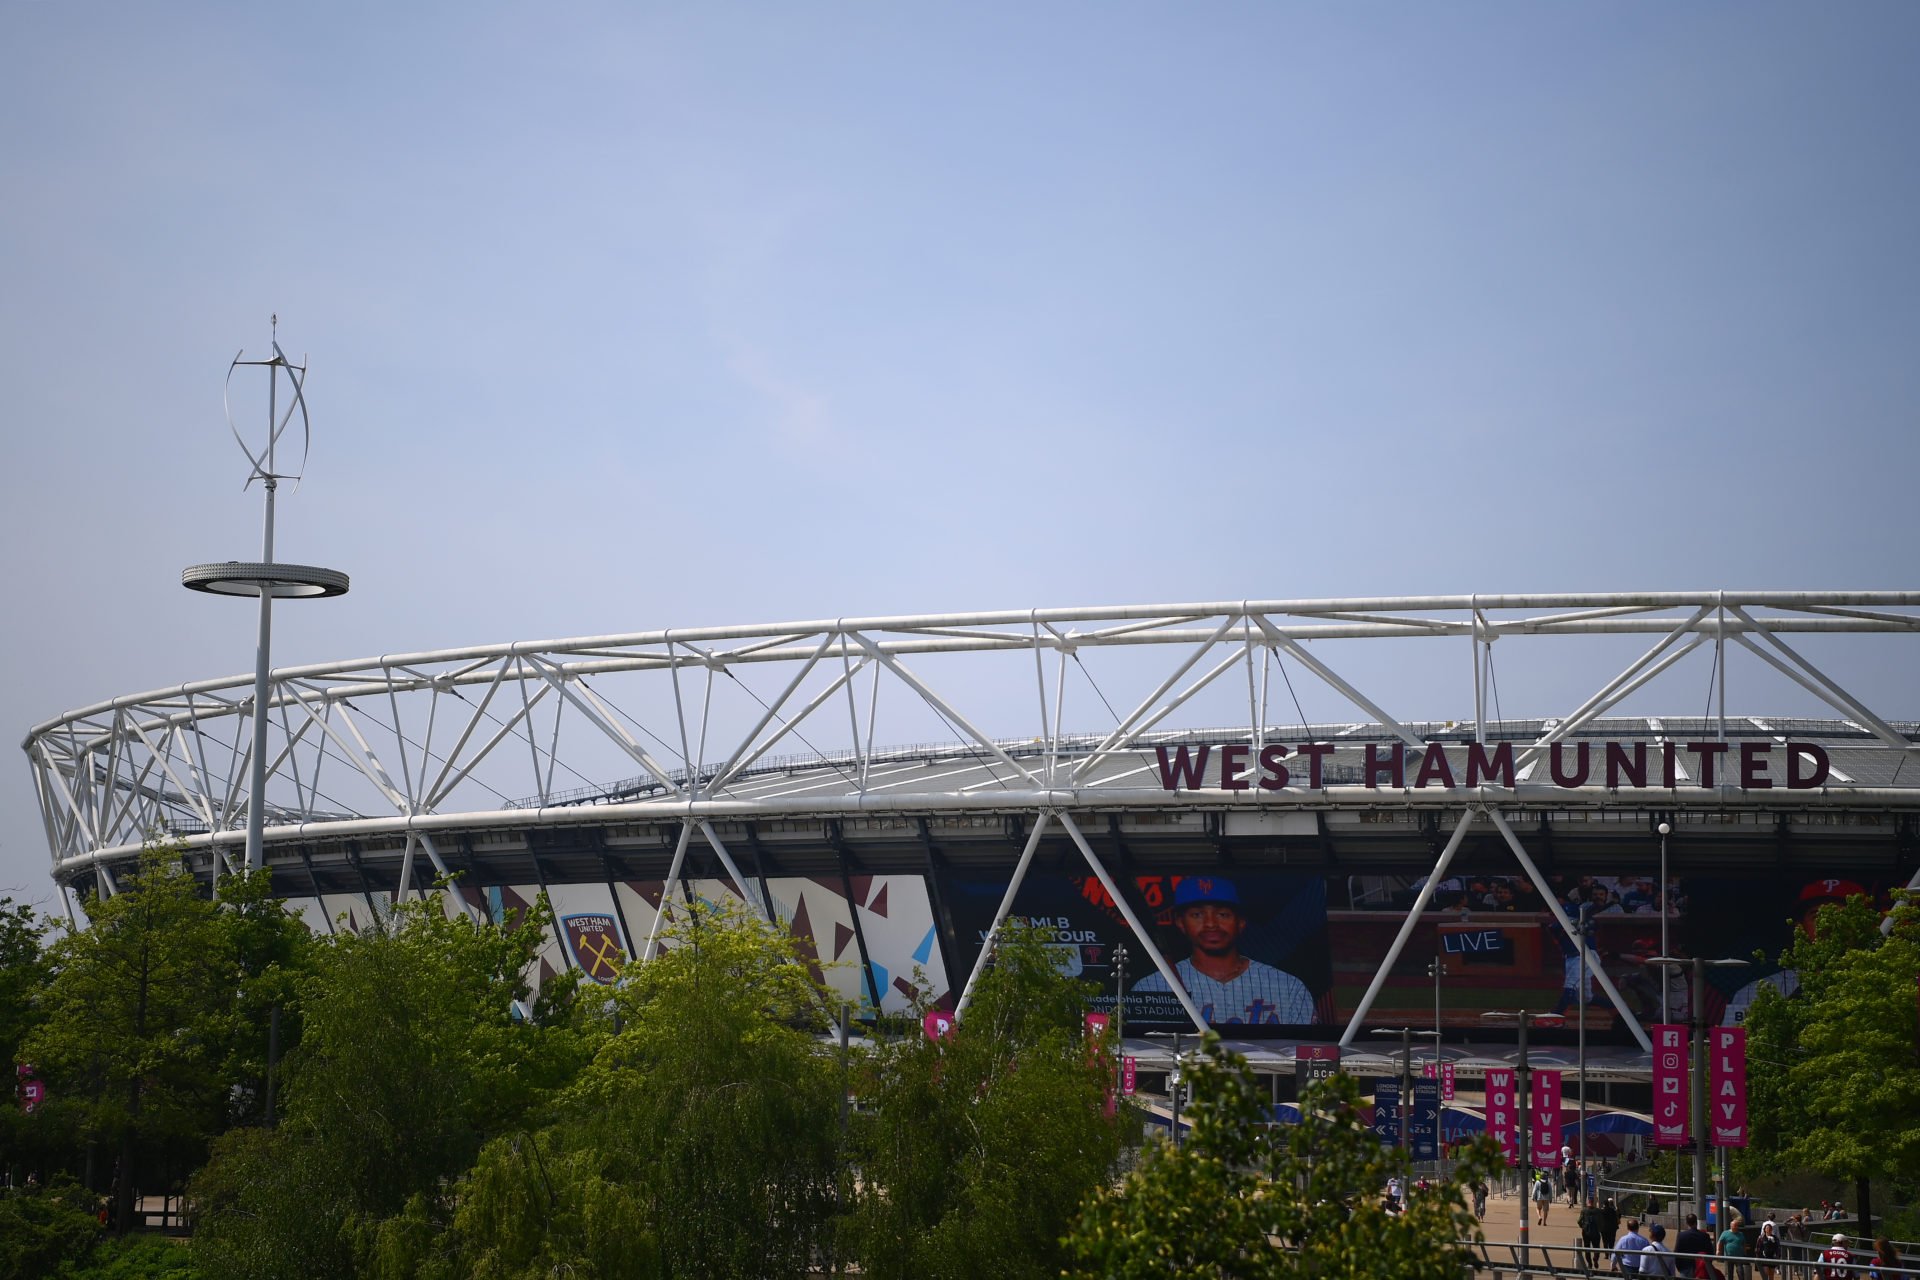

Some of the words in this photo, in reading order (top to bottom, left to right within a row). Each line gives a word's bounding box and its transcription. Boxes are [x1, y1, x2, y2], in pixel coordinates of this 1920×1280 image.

[1155, 743, 1335, 790] WEST
[1364, 742, 1516, 789] HAM
[1550, 741, 1830, 790] UNITED
[568, 917, 588, 927] WEST
[591, 917, 611, 927] HAM
[579, 925, 604, 933] UNITED
[1443, 930, 1500, 953] LIVE
[1134, 1005, 1186, 1016] STADIUM
[1720, 1033, 1737, 1120] PLAY
[1390, 1108, 1398, 1119] 1
[1491, 1073, 1509, 1145] WORK
[1540, 1075, 1553, 1146] LIVE
